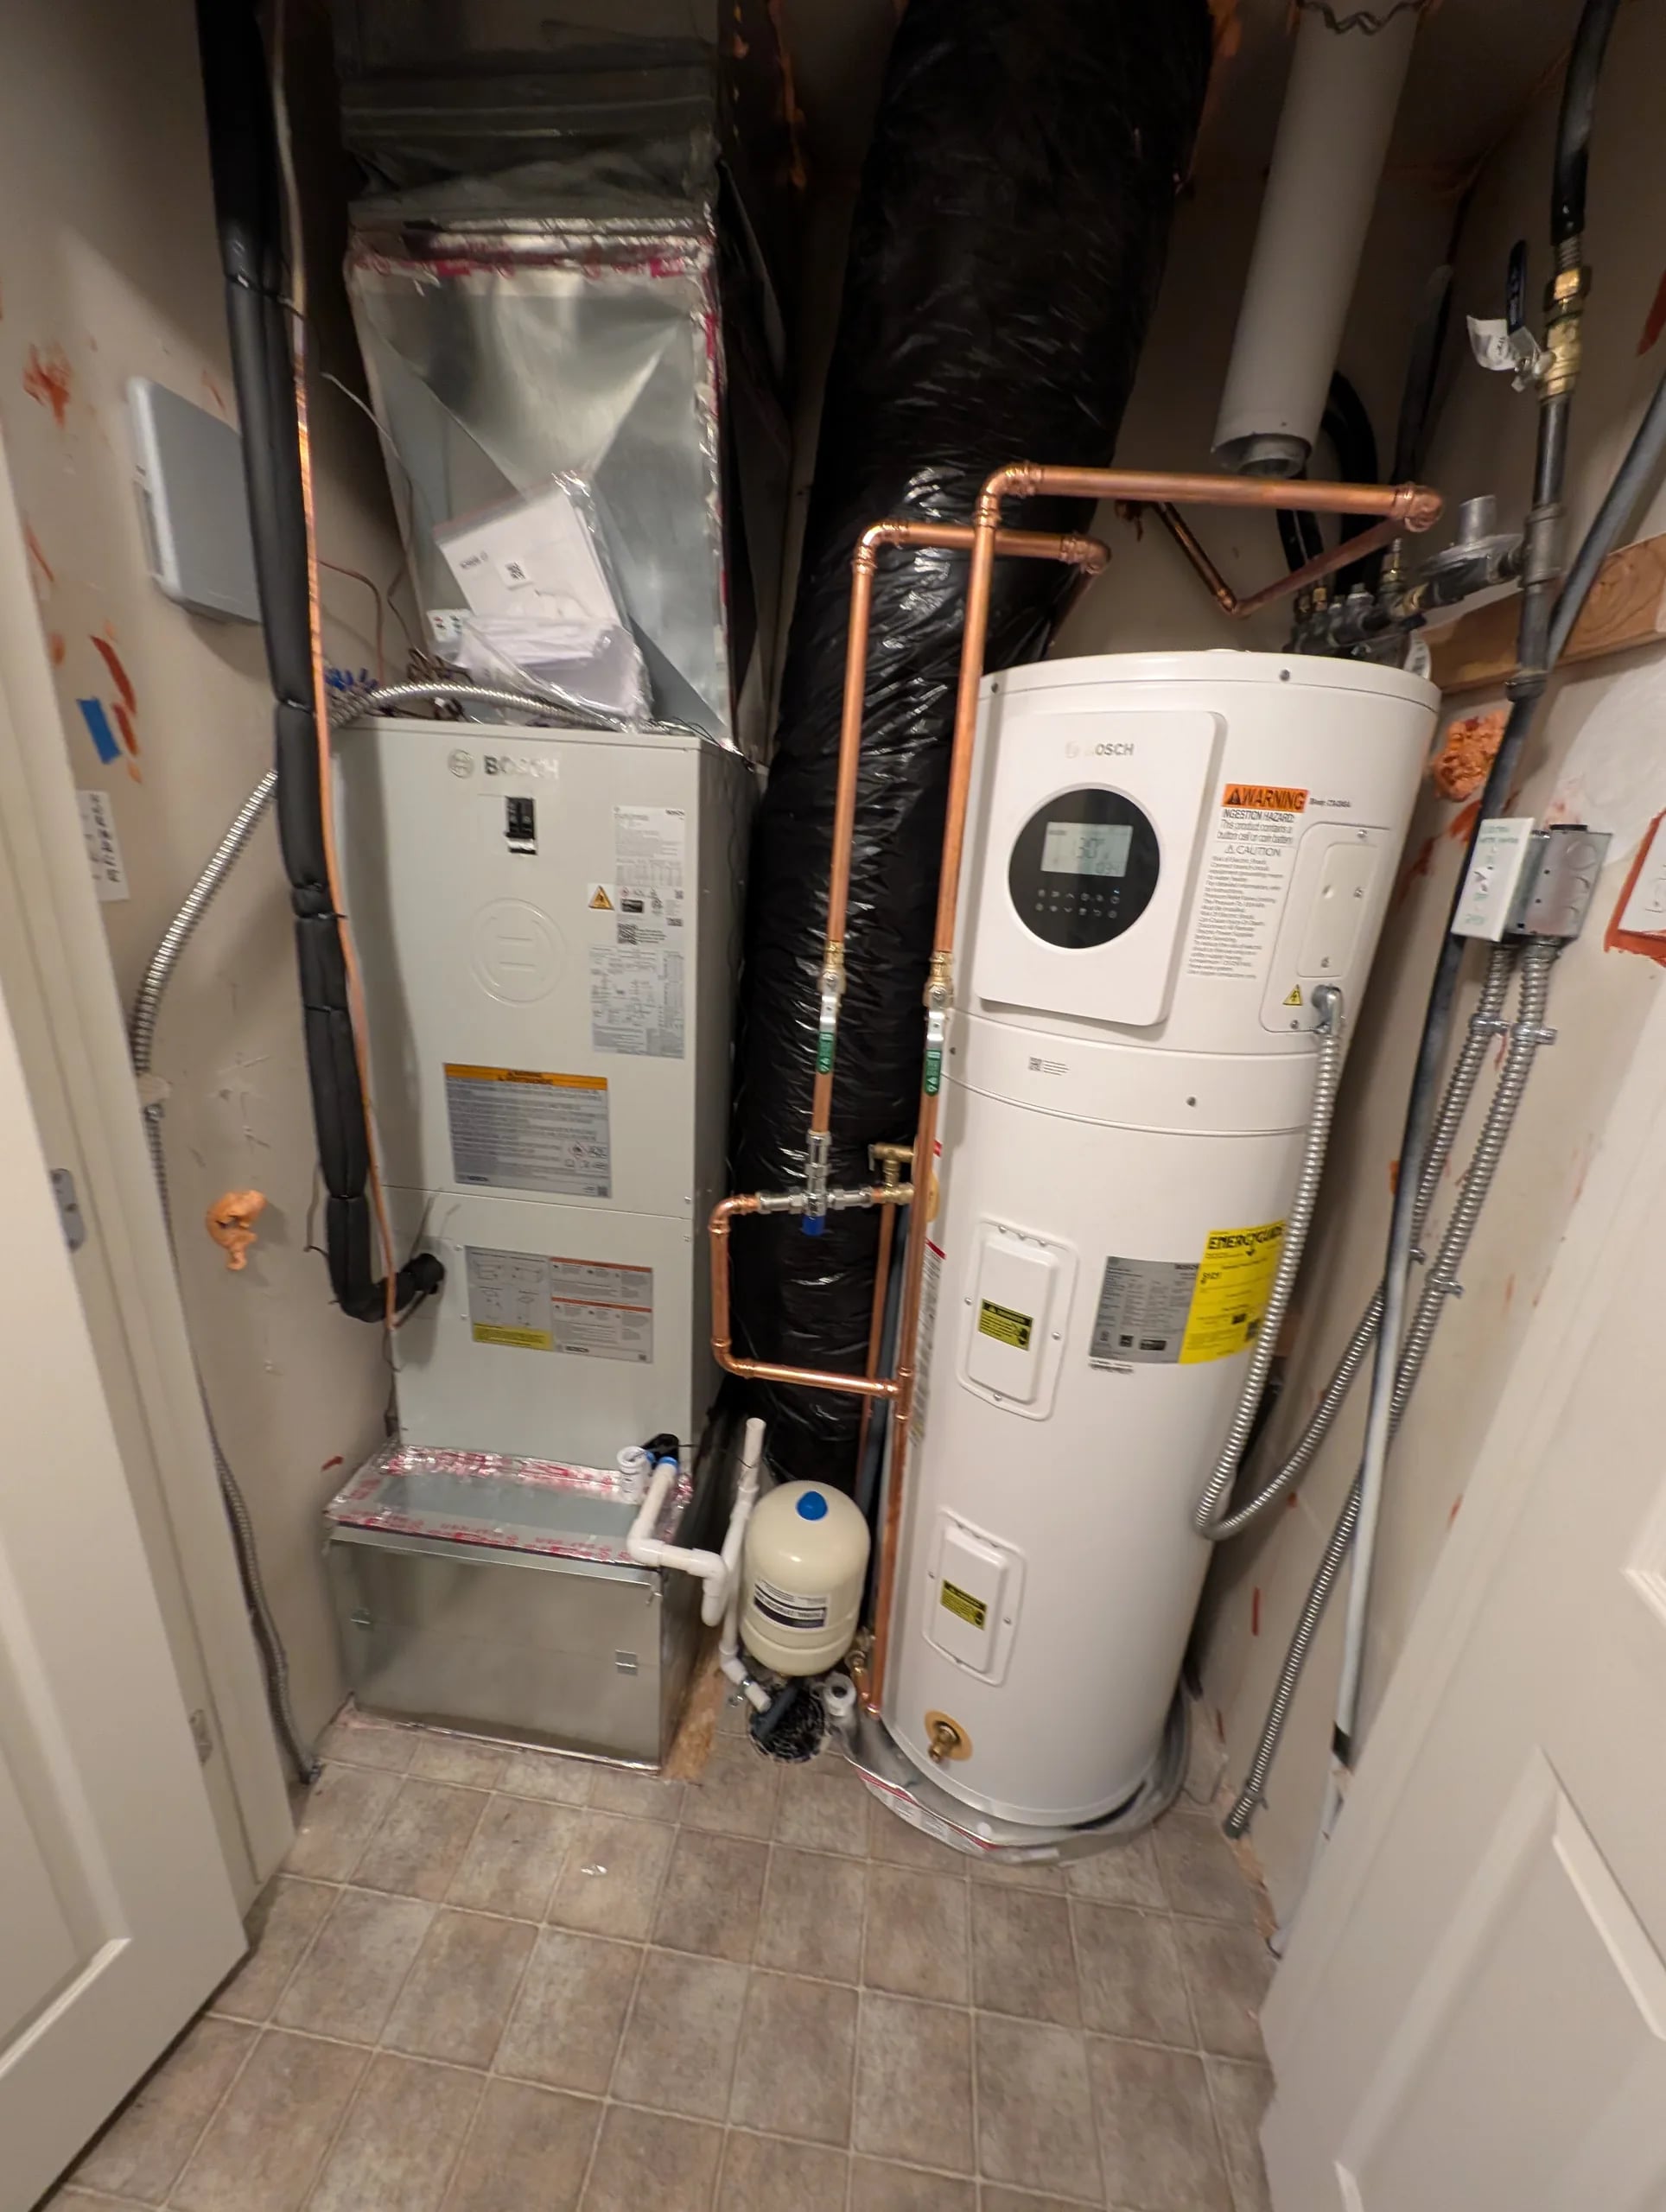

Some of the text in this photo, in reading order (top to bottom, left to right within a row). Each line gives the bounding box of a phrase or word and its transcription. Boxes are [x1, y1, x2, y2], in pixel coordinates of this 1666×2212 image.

[1084, 742, 1134, 755] OSCH
[1242, 786, 1305, 810] WARNING
[1236, 844, 1281, 857] CAUTION
